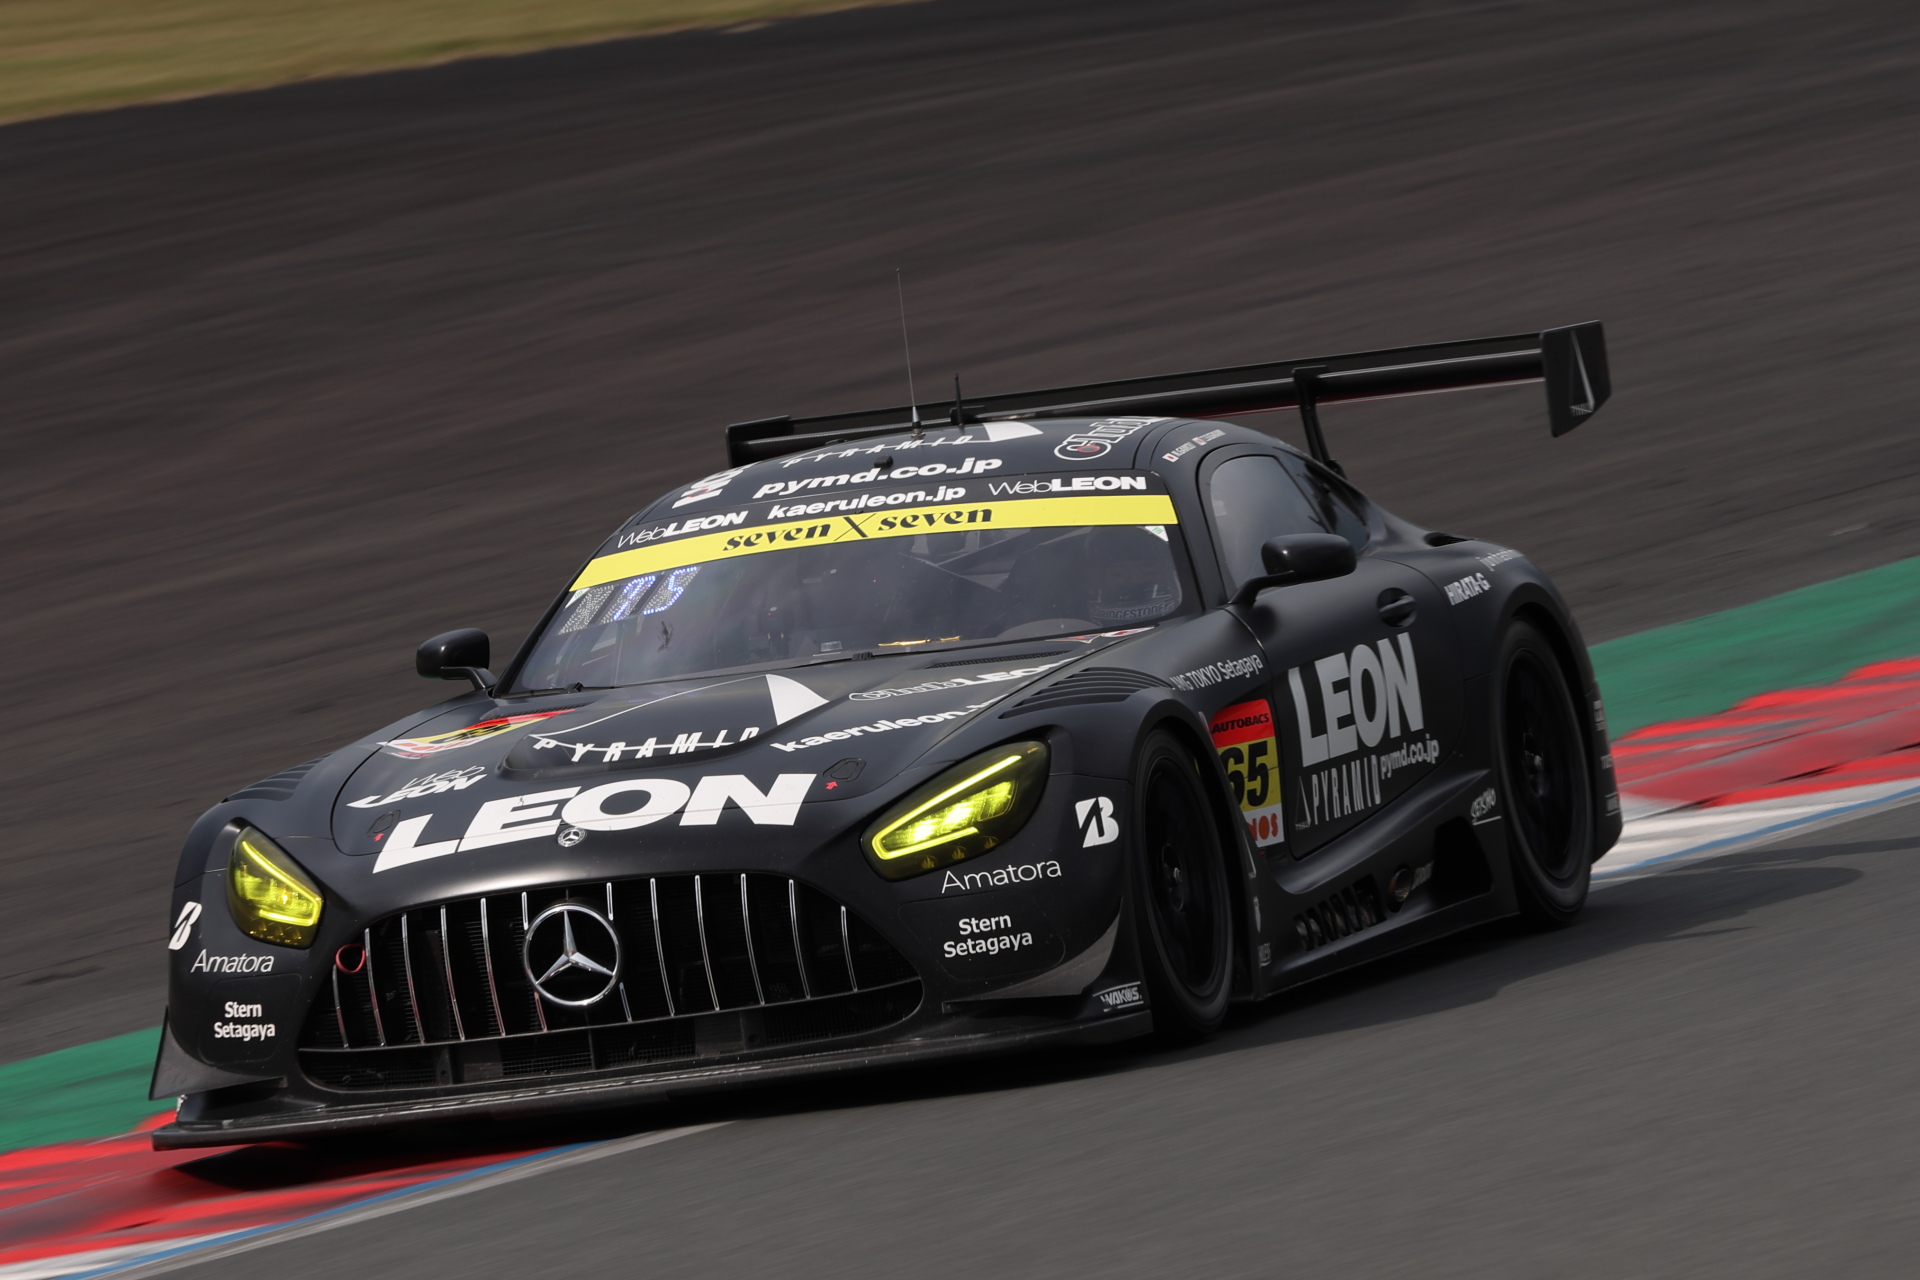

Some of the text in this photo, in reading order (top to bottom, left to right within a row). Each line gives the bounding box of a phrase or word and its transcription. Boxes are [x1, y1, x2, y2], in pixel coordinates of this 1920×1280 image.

[782, 435, 974, 468] PYRAMID
[752, 457, 1003, 499] pymd.co.jp
[988, 476, 1146, 496] WebLEON
[766, 485, 967, 520] kaeruleon.jp
[617, 511, 749, 548] WebLEON
[722, 522, 831, 551] seven
[878, 508, 992, 532] seven
[1186, 665, 1222, 689] TOKYO
[1216, 654, 1264, 679] Setagaya
[1287, 631, 1424, 768] LEON
[1211, 713, 1270, 734] AUTOBACS
[532, 727, 760, 763] PYRAMID
[1380, 733, 1440, 780] pymd.co.jp
[1219, 740, 1269, 806] 65
[1311, 754, 1382, 825] PYRAMID
[347, 774, 488, 808] LEON
[372, 773, 817, 874] LEON
[941, 860, 1062, 894] Amatora
[958, 914, 1012, 936] Stern
[190, 949, 274, 973] Amatora
[943, 931, 1033, 958] Setagaya
[224, 1001, 262, 1018] Stern
[213, 1021, 275, 1041] Setagaya
